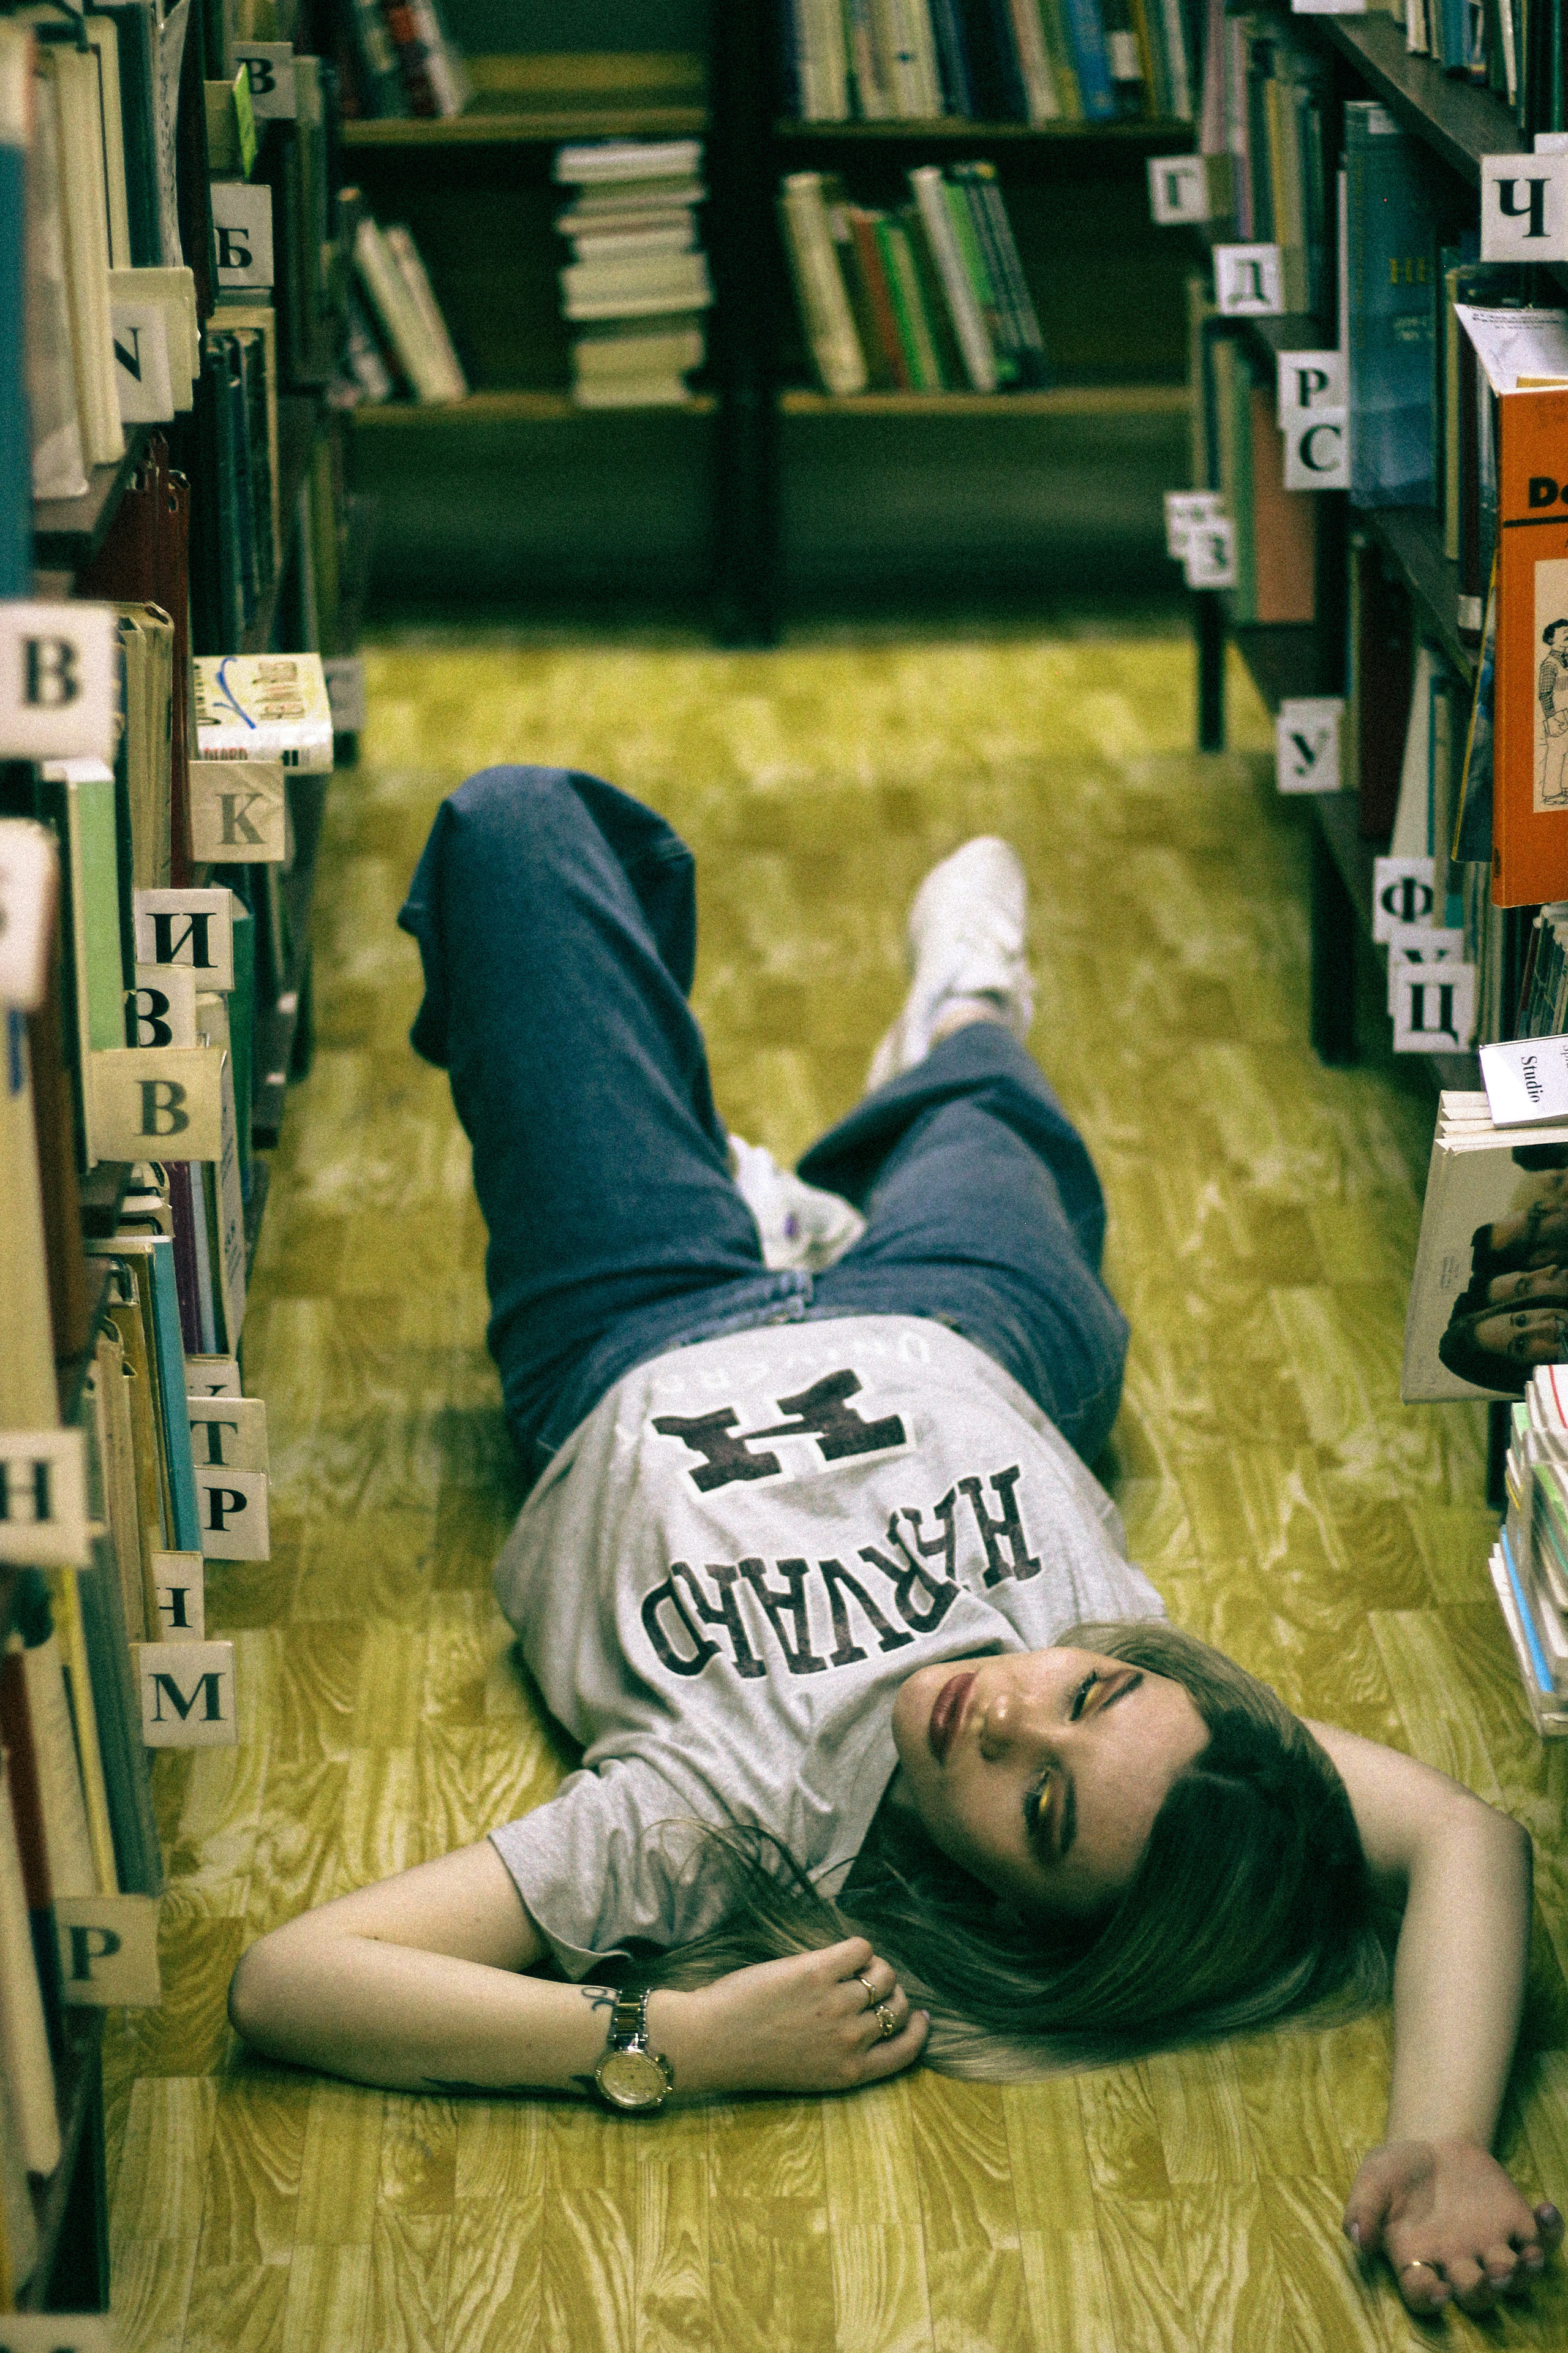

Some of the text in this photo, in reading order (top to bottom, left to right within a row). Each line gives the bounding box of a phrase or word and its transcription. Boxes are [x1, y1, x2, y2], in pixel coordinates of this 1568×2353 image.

[1493, 178, 1551, 238] Ч
[217, 228, 252, 268] Б
[1292, 369, 1328, 407] Р
[1299, 424, 1341, 472] С
[23, 636, 82, 709] В
[215, 793, 267, 845] К
[1380, 877, 1434, 923] Ф
[146, 912, 218, 969] И
[1521, 1056, 1543, 1103] Studio
[136, 1079, 190, 1137] В
[189, 1420, 239, 1465] Т
[202, 1486, 248, 1532] Р
[641, 1464, 1042, 1680] HARVARD
[148, 1672, 227, 1722] М
[60, 1925, 121, 1981] Р
